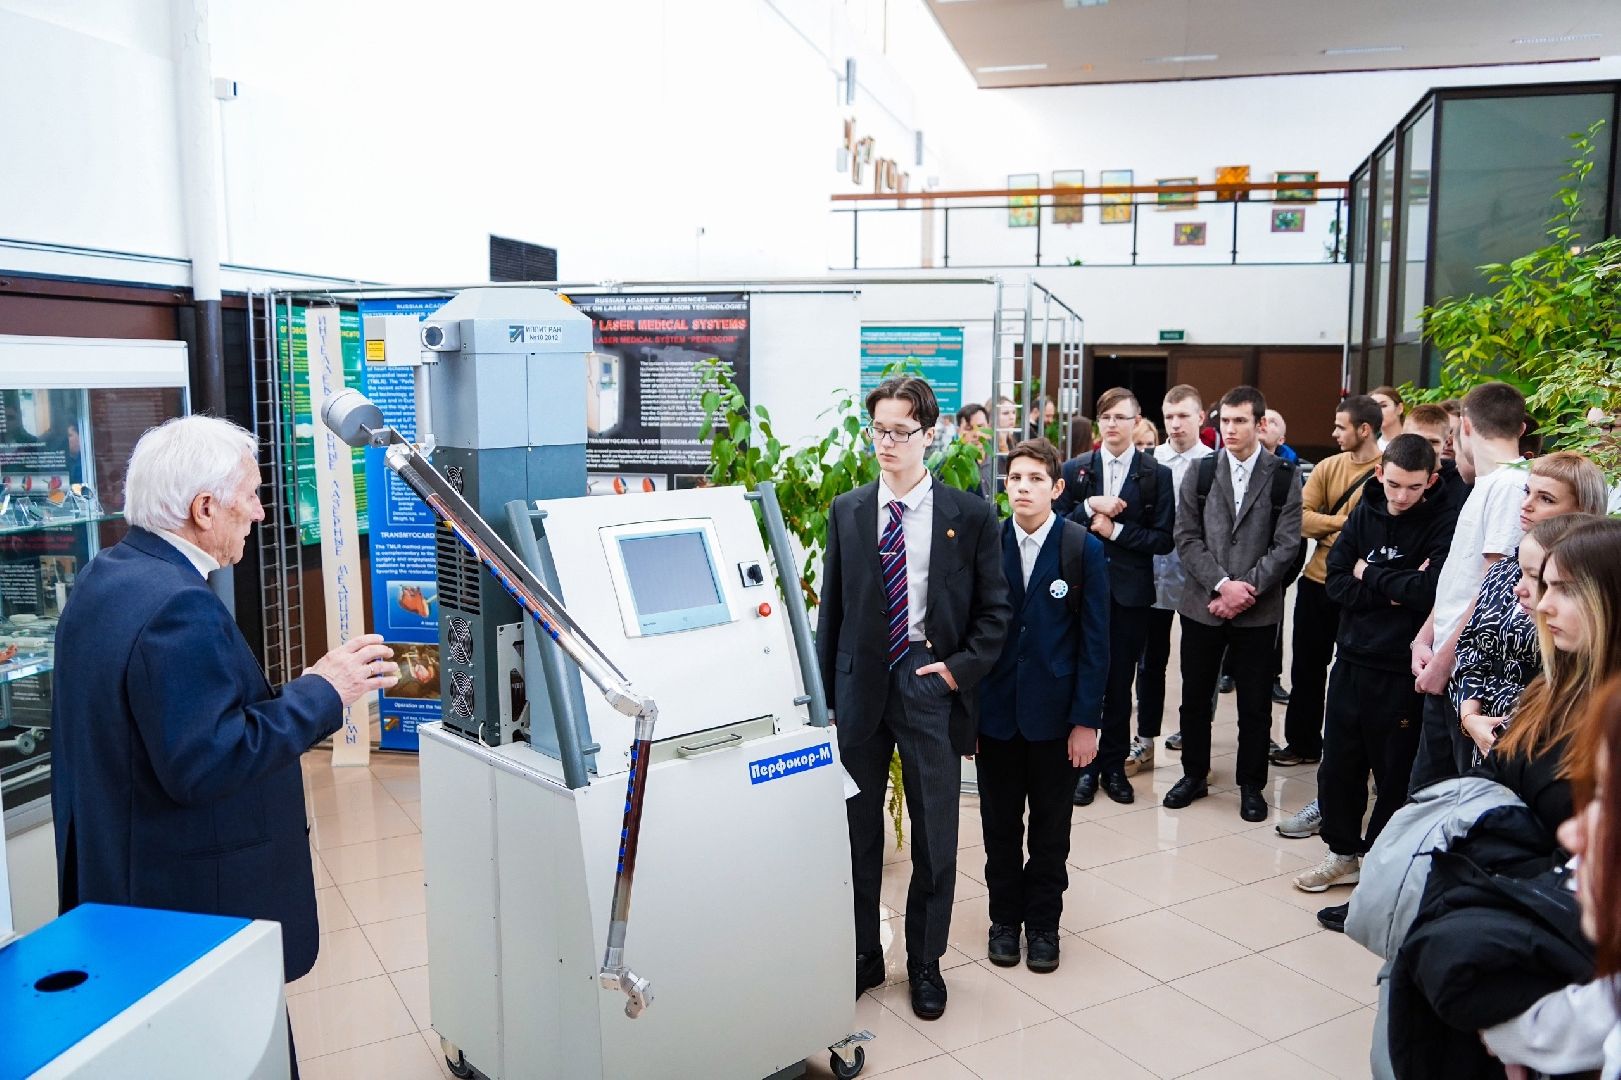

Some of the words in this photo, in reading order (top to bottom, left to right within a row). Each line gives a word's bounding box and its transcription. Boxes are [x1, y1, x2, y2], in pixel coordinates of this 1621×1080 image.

[692, 303, 747, 311] TECHNOLOGIES
[599, 319, 636, 331] LASER
[638, 319, 689, 331] MEDICAL
[692, 318, 748, 330] SYSTEMS
[594, 336, 619, 344] LASER
[620, 336, 654, 344] MEDICAL
[655, 335, 687, 344] SYSTEM
[380, 531, 436, 539] TRANSMYOCARD
[344, 704, 358, 745] ТЕМЫ
[750, 746, 832, 779] Перфокор-М
